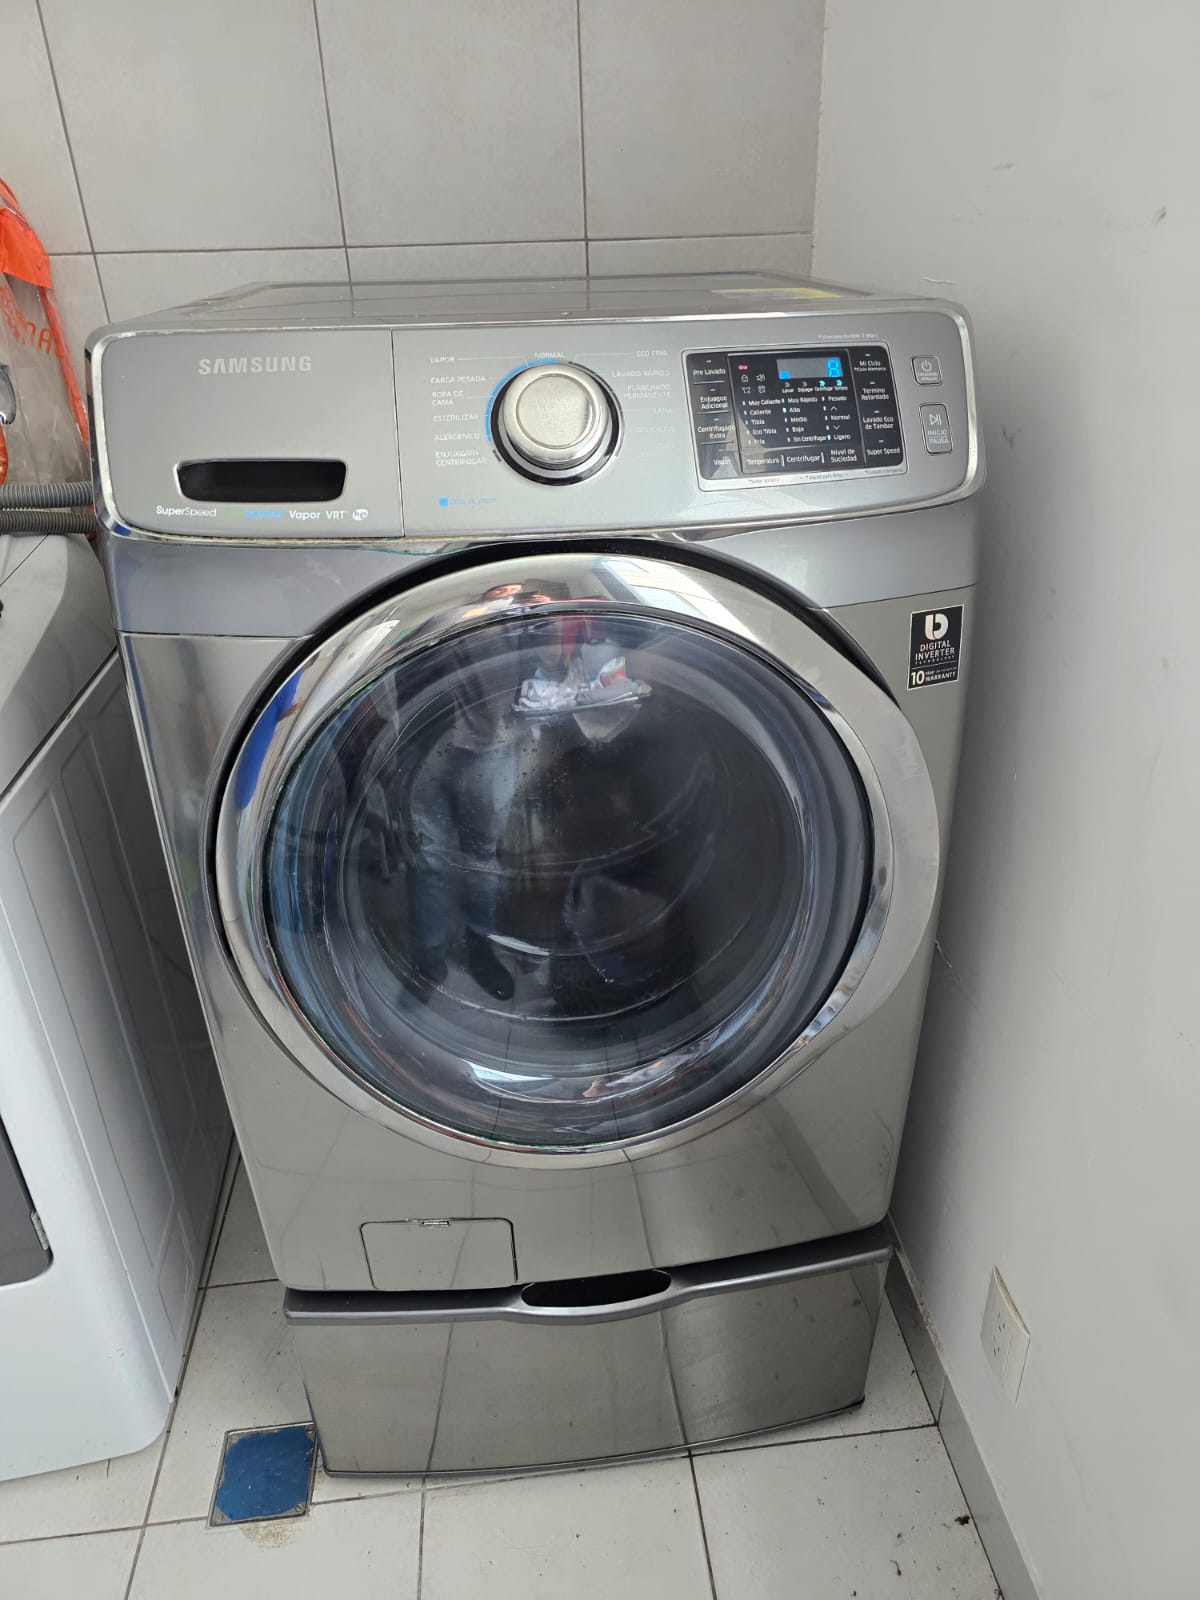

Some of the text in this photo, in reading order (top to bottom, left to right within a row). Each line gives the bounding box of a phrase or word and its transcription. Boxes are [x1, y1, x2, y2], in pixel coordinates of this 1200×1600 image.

[198, 355, 312, 376] SAMSUNG
[430, 356, 455, 364] VAPOR
[866, 448, 883, 456] Super
[786, 454, 821, 463] Centrifugar
[830, 455, 857, 463] Suciedad
[155, 505, 217, 518] SuperSpeed
[289, 510, 321, 521] Vapor
[326, 510, 345, 520] VRT
[919, 639, 951, 652] DIGITAL
[915, 647, 955, 661] INVERTER
[910, 670, 926, 686] 10
[925, 671, 956, 682] WARRANTY
